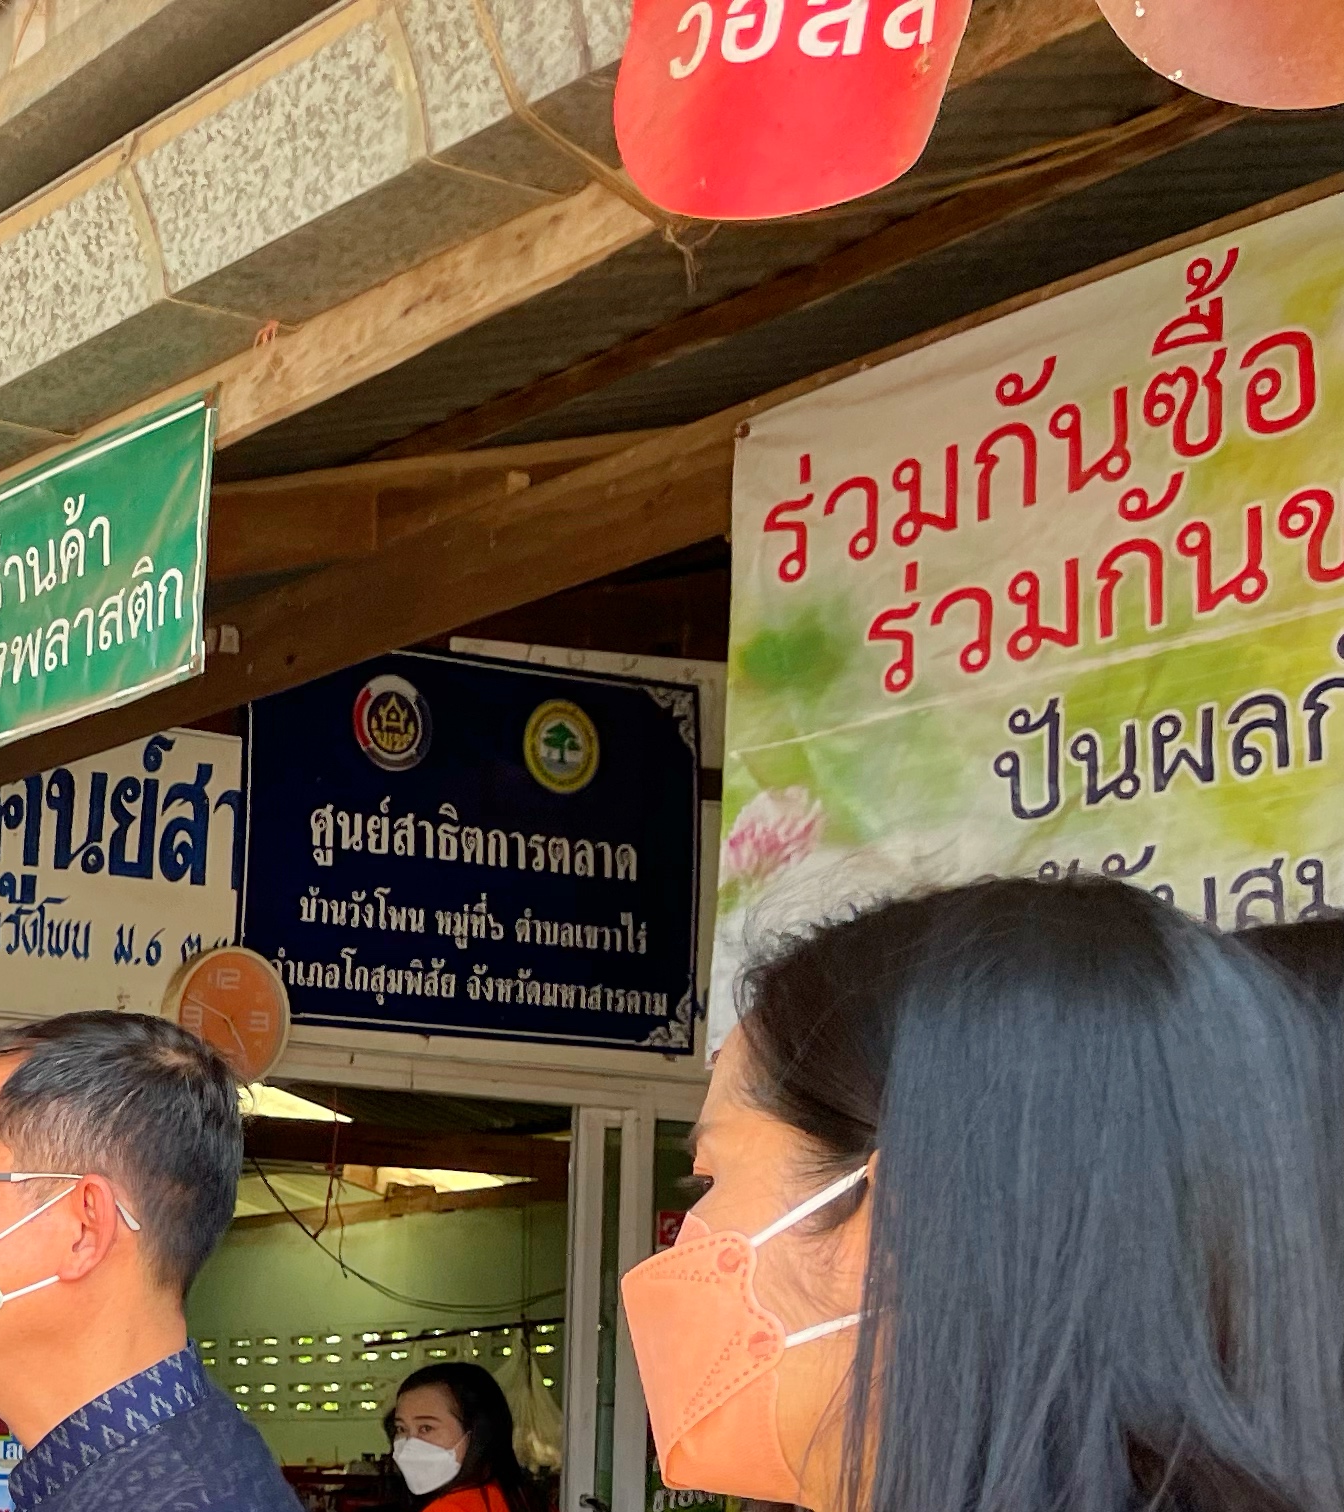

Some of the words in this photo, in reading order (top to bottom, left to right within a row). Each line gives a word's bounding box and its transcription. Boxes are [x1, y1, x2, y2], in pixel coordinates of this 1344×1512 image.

[763, 248, 1318, 583] ร่วมกันซื้อ
[994, 634, 1344, 821] ปันผลก
[310, 795, 638, 882] ศูนย์สาธิตการตลาด
[299, 886, 426, 934] บ้านวังโพน
[514, 907, 648, 955] ตำบลเขวาไร่
[466, 962, 669, 1018] จังหวัดมหาสารคาม
